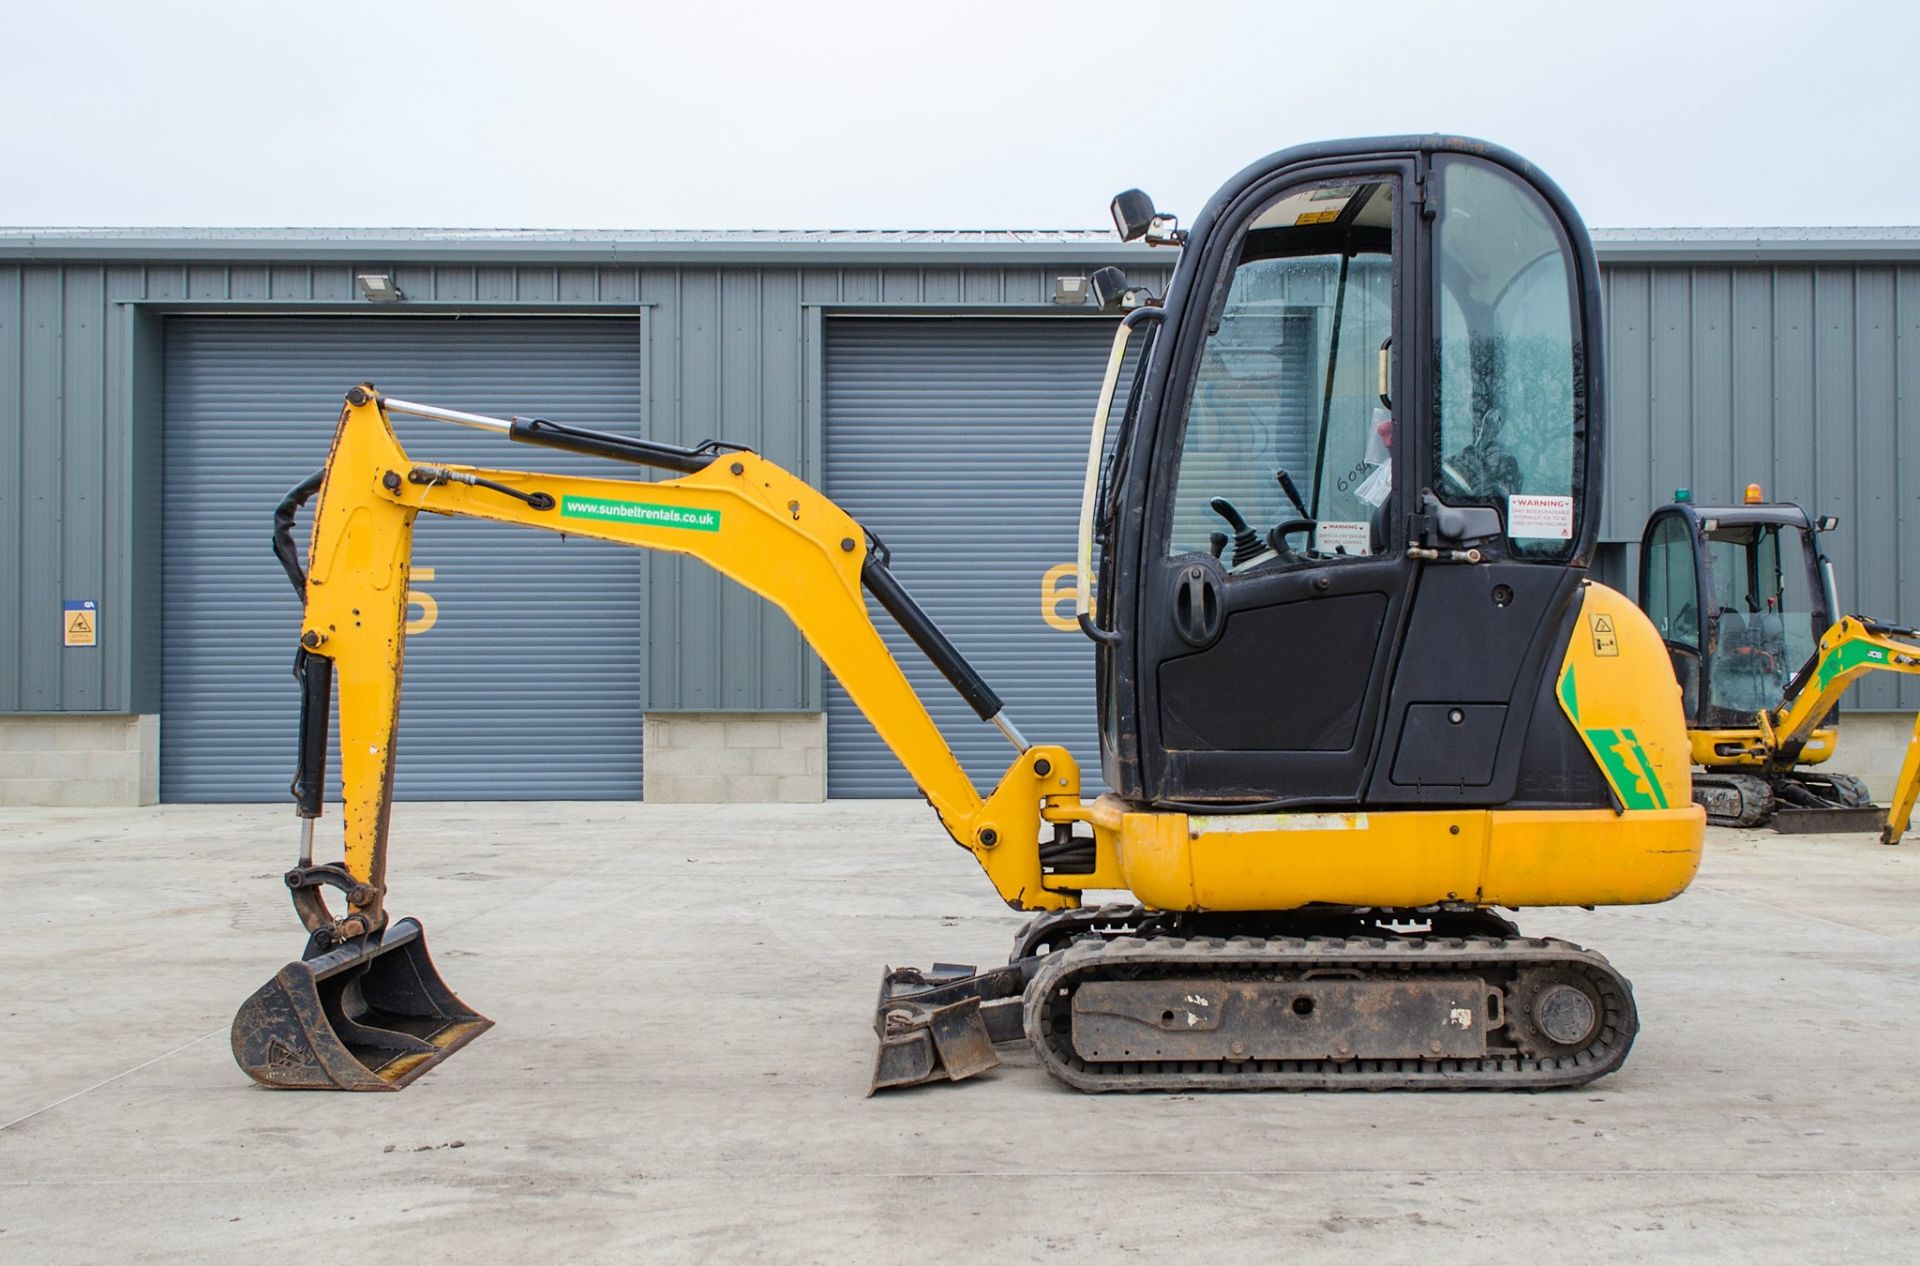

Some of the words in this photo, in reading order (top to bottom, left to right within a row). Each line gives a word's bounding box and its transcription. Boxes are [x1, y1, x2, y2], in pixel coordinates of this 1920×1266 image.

[1517, 499, 1564, 507] WARNING
[567, 501, 714, 526] www.sunbeltrentals.co.uk
[1041, 563, 1097, 632] 6
[1867, 649, 1883, 659] JCB
